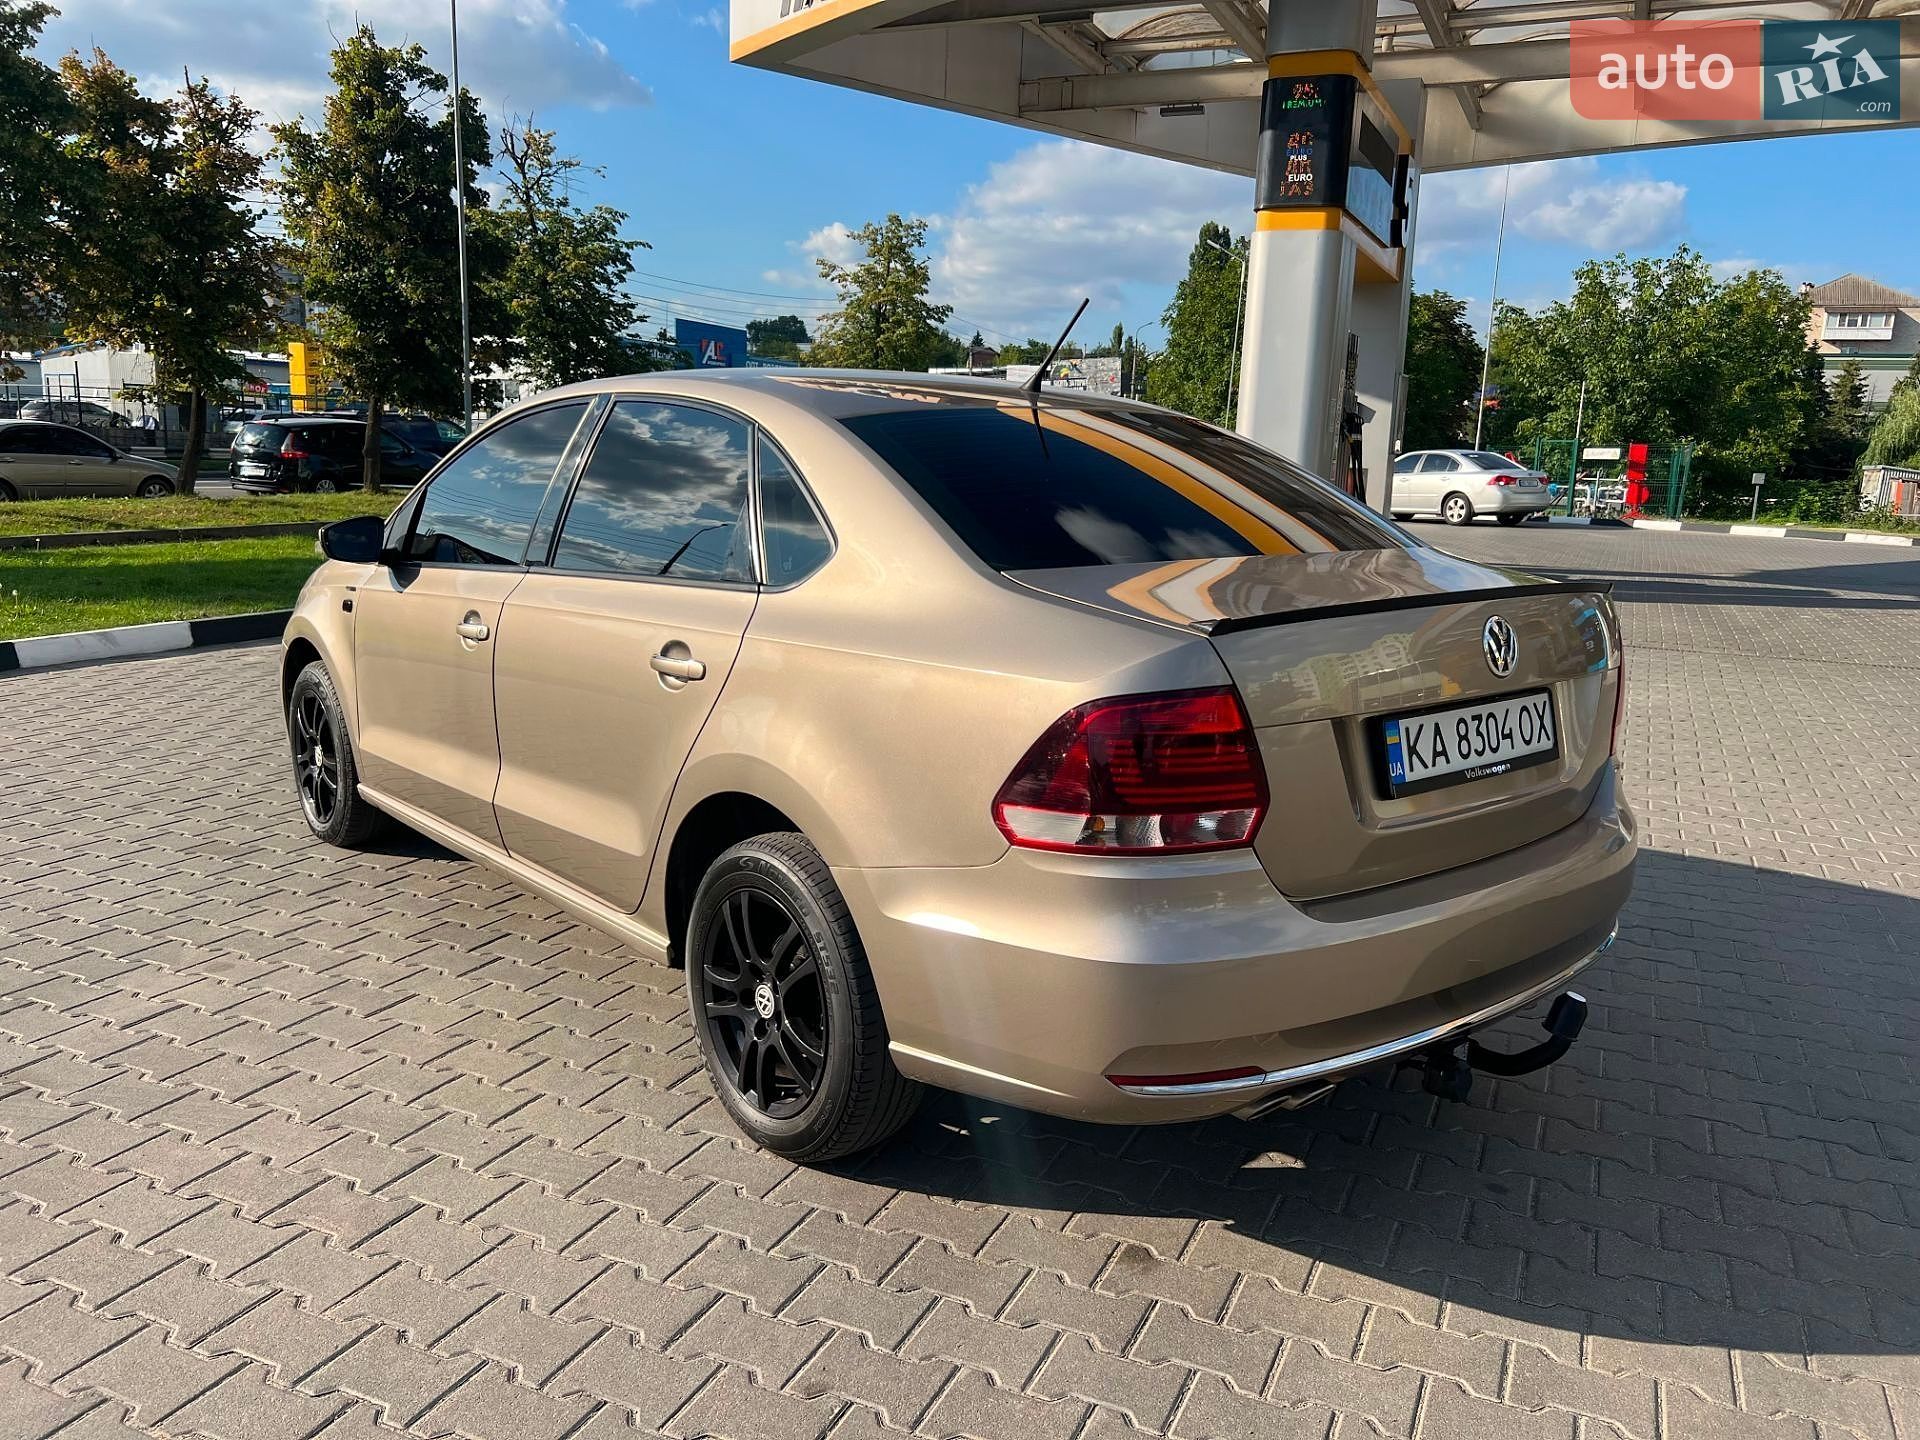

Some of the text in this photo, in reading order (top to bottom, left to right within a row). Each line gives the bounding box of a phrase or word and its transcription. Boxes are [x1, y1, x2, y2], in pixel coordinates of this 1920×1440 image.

[1288, 173, 1313, 182] EURO
[1405, 700, 1551, 773] KA 8304 OX
[1389, 763, 1404, 777] UA
[1464, 763, 1511, 779] Volkswagen
